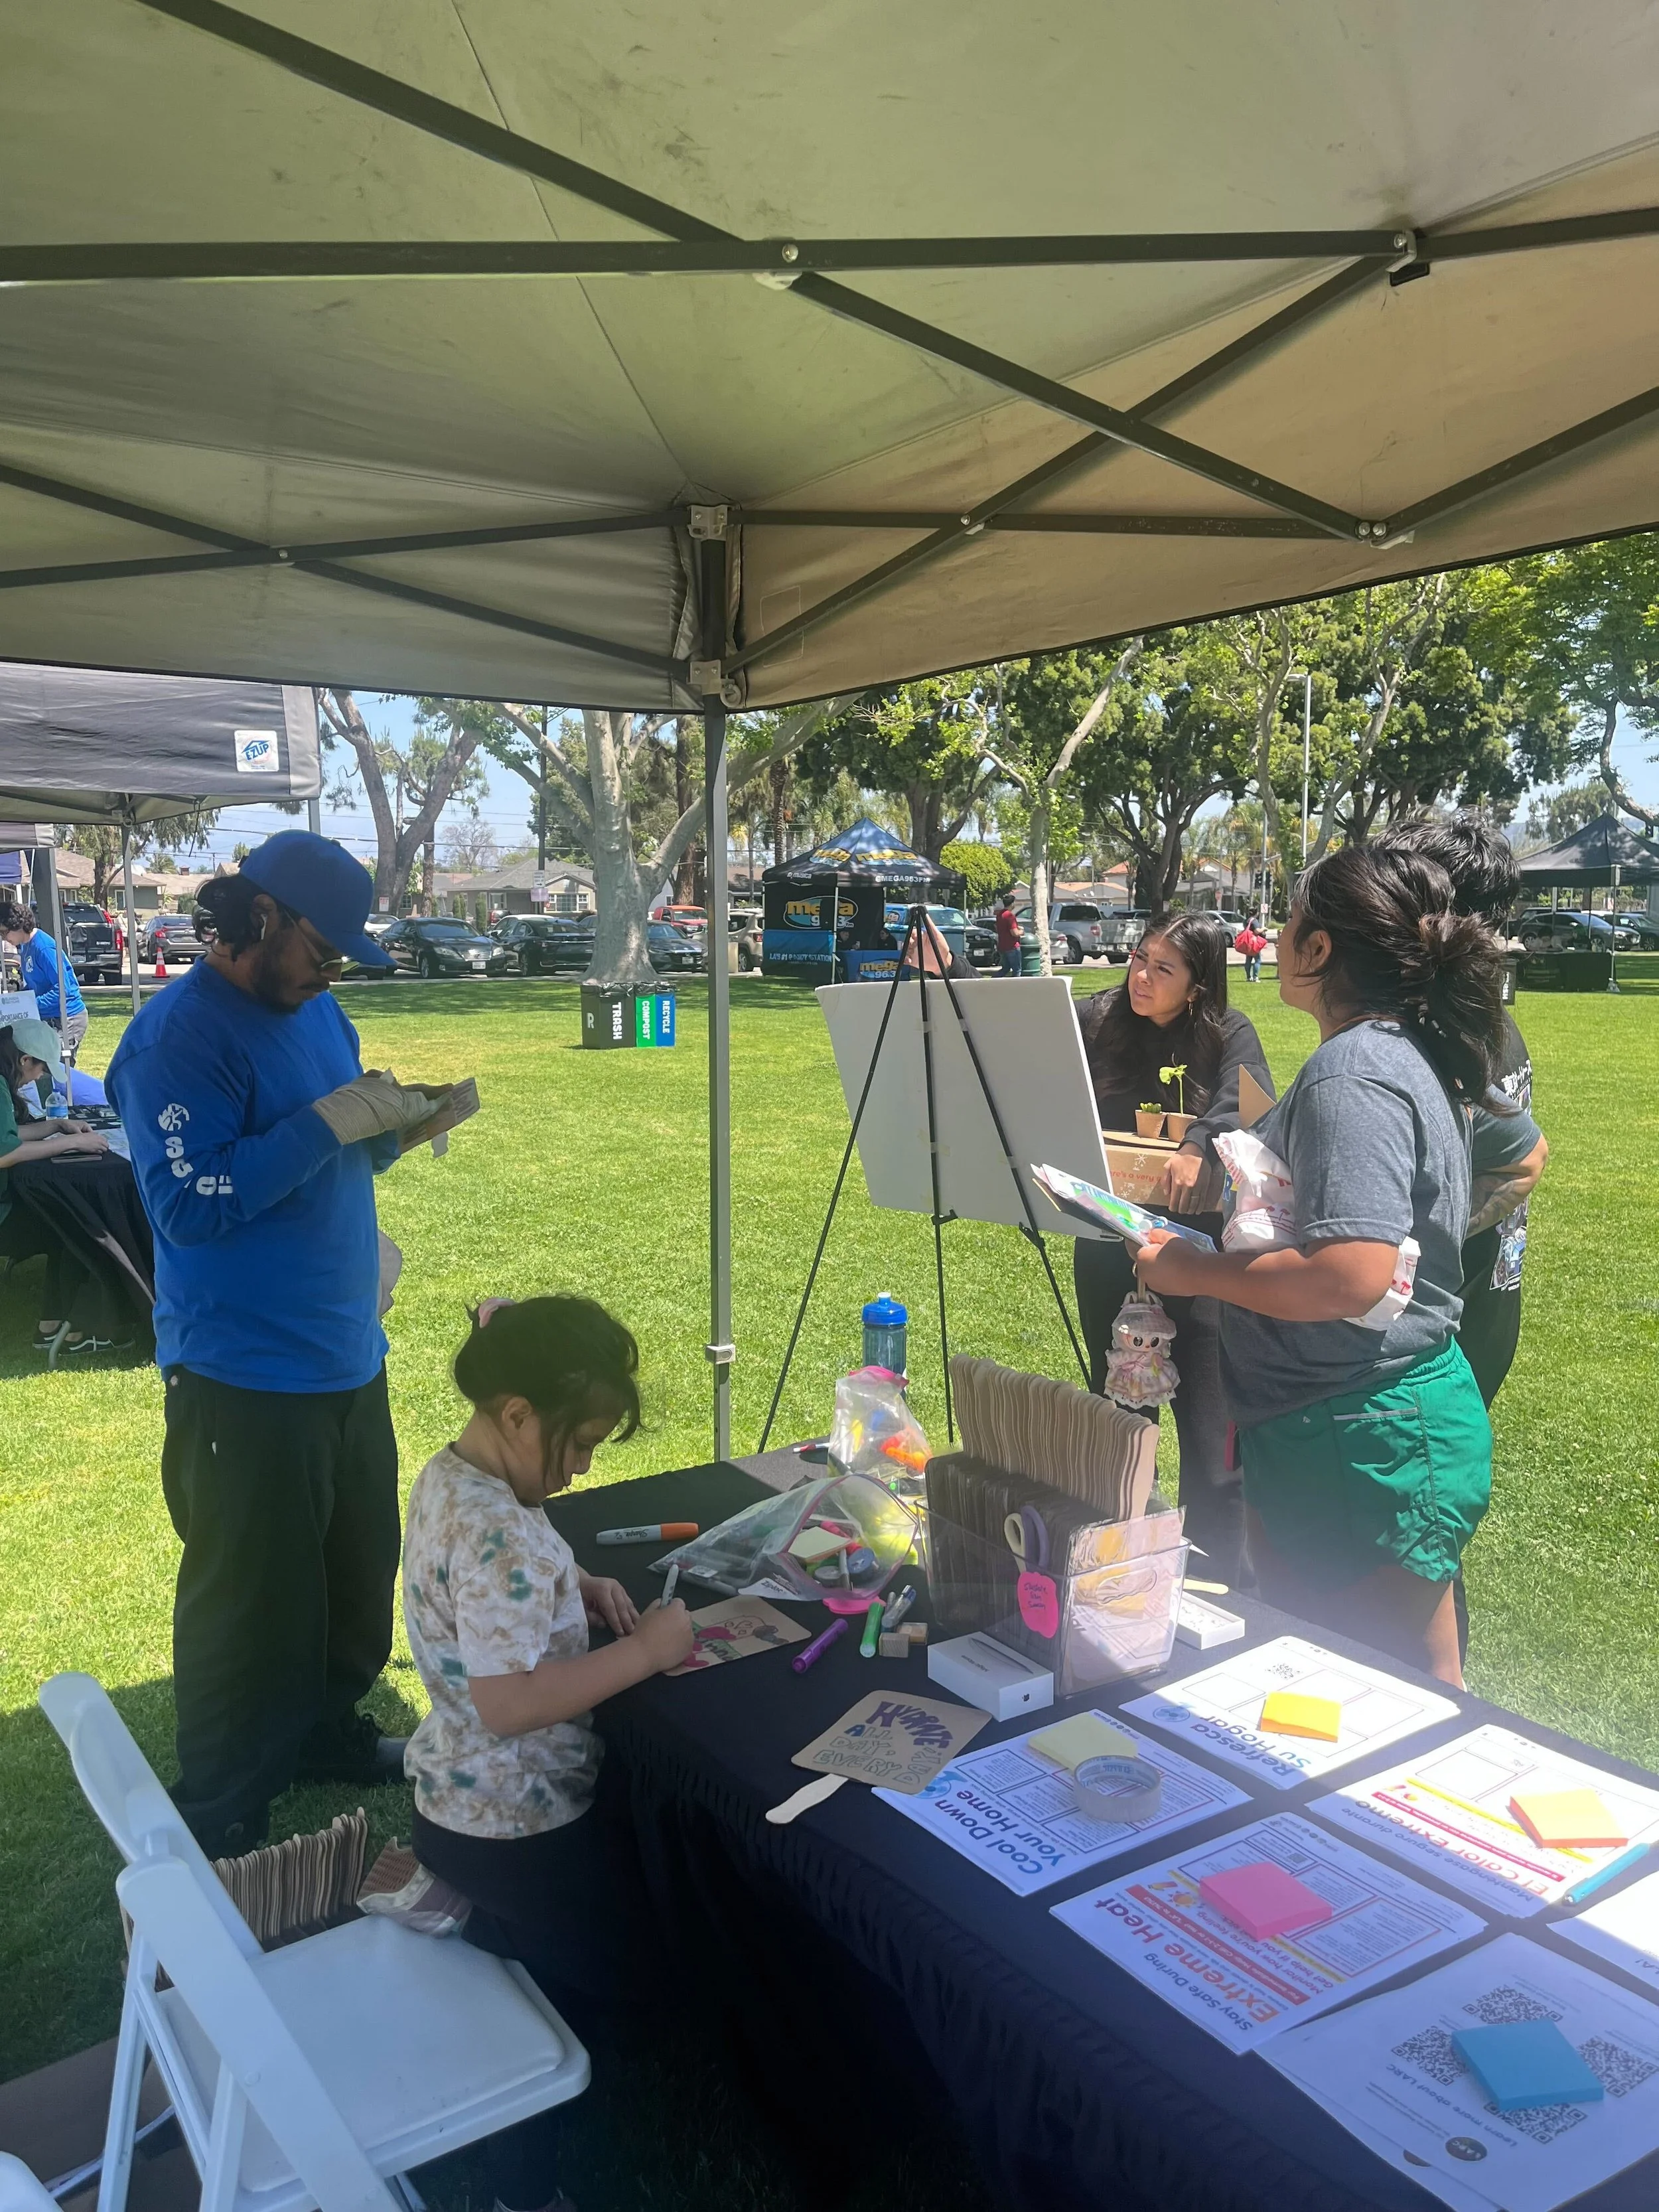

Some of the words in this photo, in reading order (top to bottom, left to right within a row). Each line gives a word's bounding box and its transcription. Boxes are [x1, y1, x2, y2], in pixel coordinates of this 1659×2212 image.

[855, 849, 918, 861] mega
[788, 901, 855, 916] mea
[612, 1001, 622, 1040] TRASH
[642, 1000, 651, 1040] COMPOST
[1136, 1174, 1154, 1183] very
[843, 1724, 893, 1740] ALL
[865, 1701, 954, 1749] HYDRATE
[1200, 1716, 1276, 1751] Hogar
[829, 1735, 896, 1756] DAY,
[1190, 1724, 1297, 1777] Refresca
[812, 1749, 902, 1777] EVERY
[1279, 1751, 1312, 1769] Su
[934, 1799, 995, 1840] Down
[956, 1790, 1019, 1832] Home
[1341, 1807, 1393, 1834] durante
[1354, 1800, 1449, 1848] Extremo
[985, 1839, 1043, 1874] Cool
[1013, 1832, 1066, 1867] Your
[1395, 1832, 1443, 1858] seguro
[1452, 1849, 1519, 1880] Calor
[1522, 1880, 1550, 1895] El
[1094, 1898, 1164, 1944] Heat
[1230, 1934, 1262, 1956] you're
[1262, 1941, 1282, 1956] you
[1143, 1953, 1189, 1987] During
[1263, 1955, 1283, 1969] how
[1291, 1961, 1314, 1976] help
[1164, 1943, 1280, 2023] Extreme
[1282, 1968, 1323, 1994] Monitor
[1314, 1976, 1334, 1988] Get
[1188, 1986, 1221, 2008] Safe
[1219, 2006, 1253, 2031] Stay
[1386, 2064, 1417, 2085] LARC
[1417, 2085, 1451, 2106] about
[1453, 2106, 1482, 2126] more
[1484, 2124, 1518, 2147] Learn
